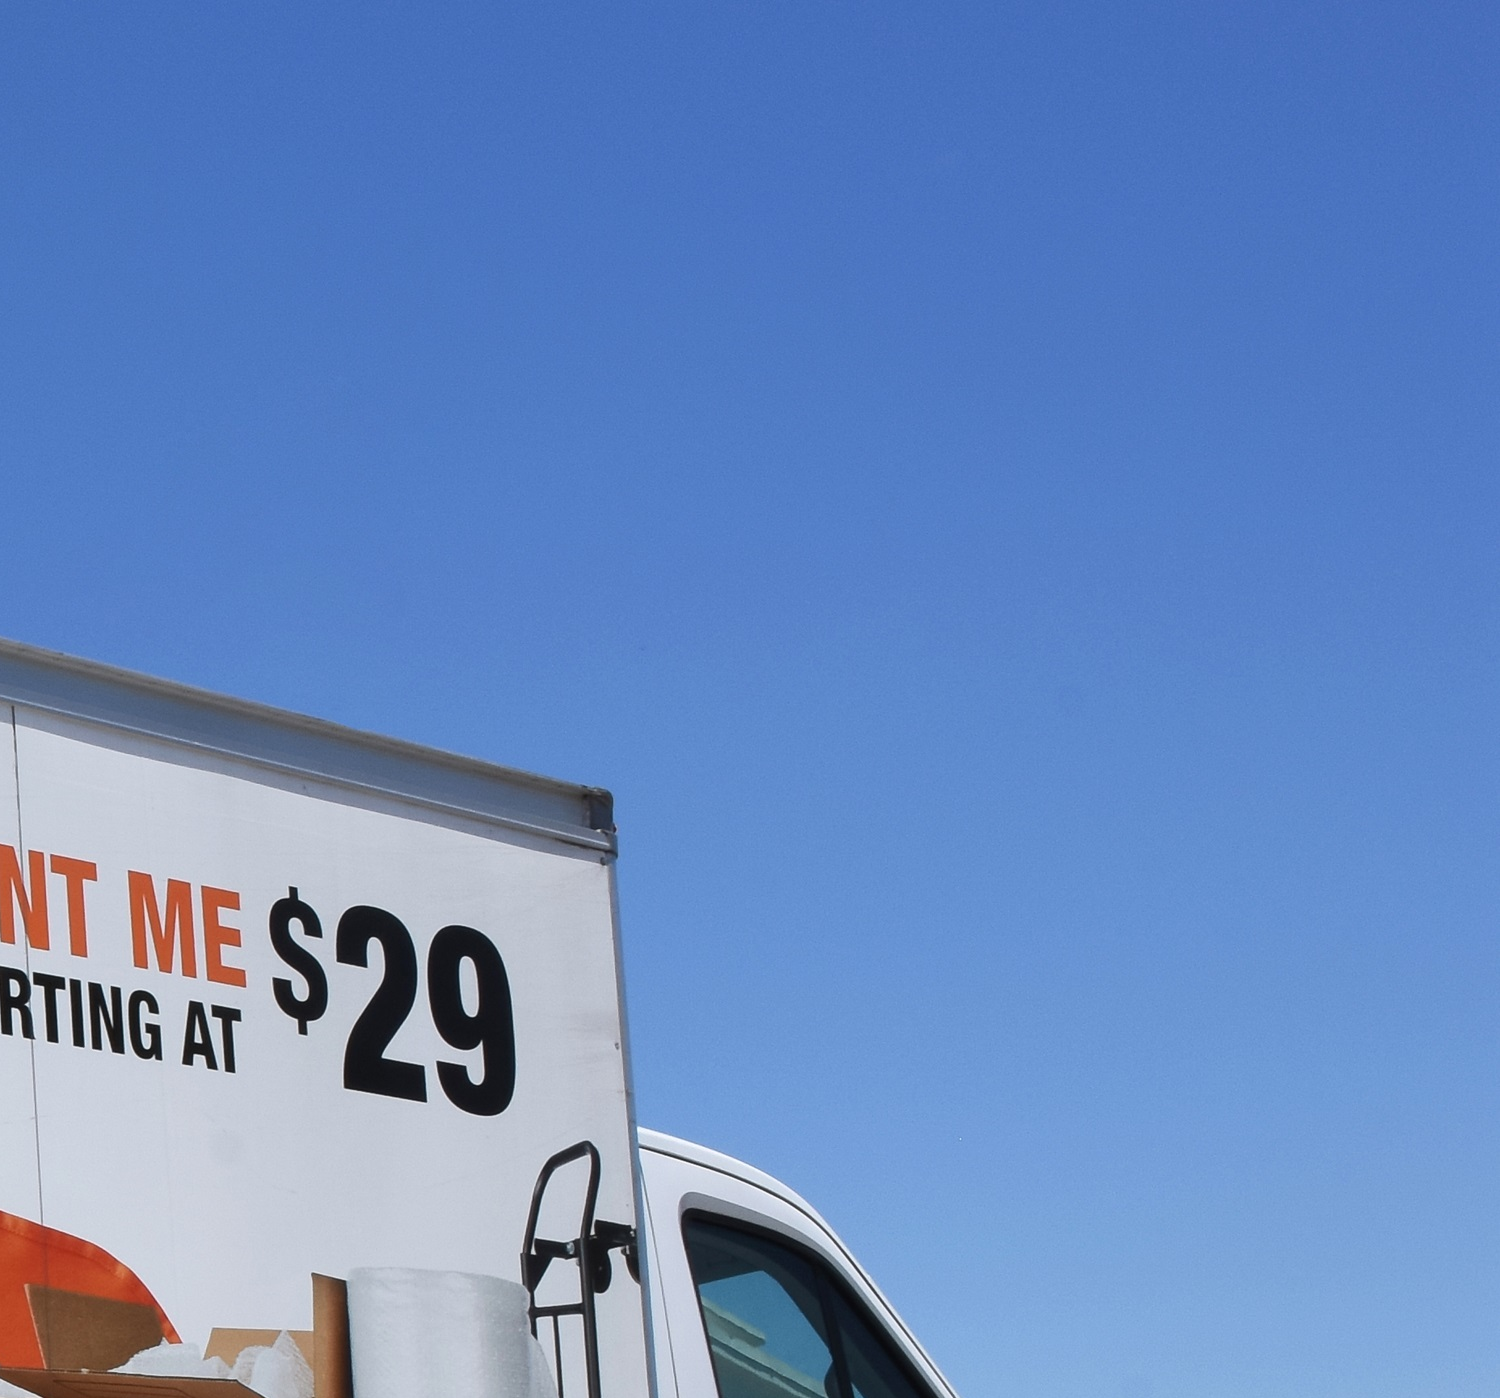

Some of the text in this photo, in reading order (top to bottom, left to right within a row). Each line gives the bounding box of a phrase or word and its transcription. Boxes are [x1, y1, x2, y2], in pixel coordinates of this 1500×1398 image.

[127, 869, 247, 989] ME
[269, 886, 517, 1117] $29
[181, 1000, 242, 1073] AT
